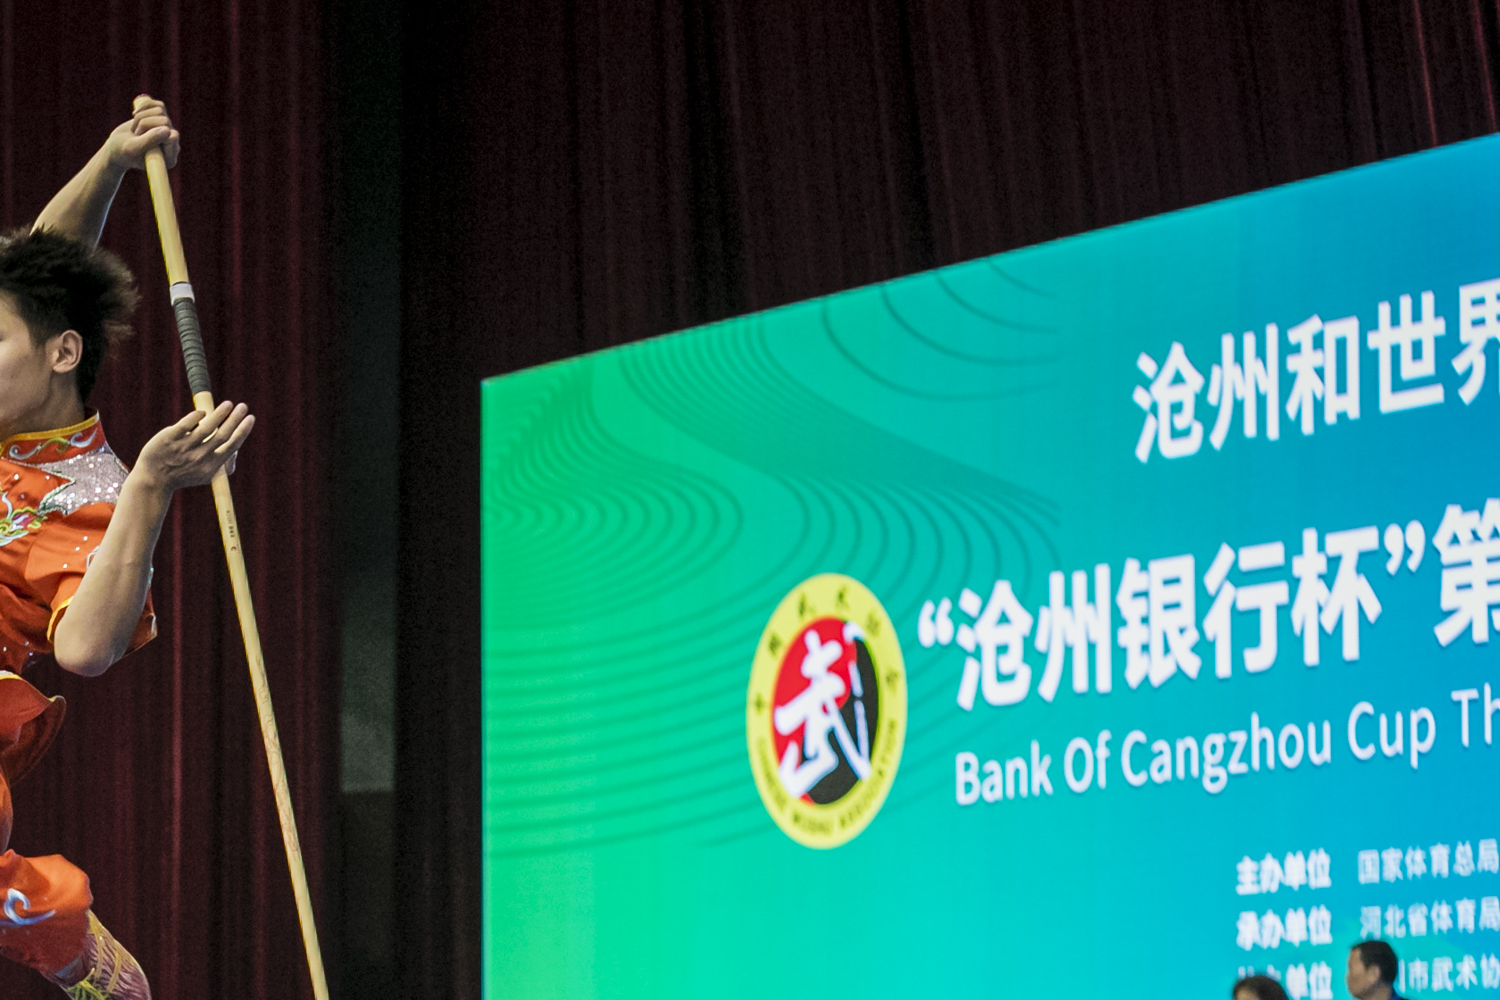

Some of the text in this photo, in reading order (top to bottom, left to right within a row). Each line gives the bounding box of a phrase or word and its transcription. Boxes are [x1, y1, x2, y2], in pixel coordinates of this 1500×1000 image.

[1133, 276, 1500, 463] 沧州和世界
[955, 740, 1054, 806] Bank
[1064, 730, 1112, 794] Of
[1120, 712, 1332, 795] Cangzhou
[1348, 701, 1436, 769] Cup
[1399, 953, 1500, 994] 市武术协
